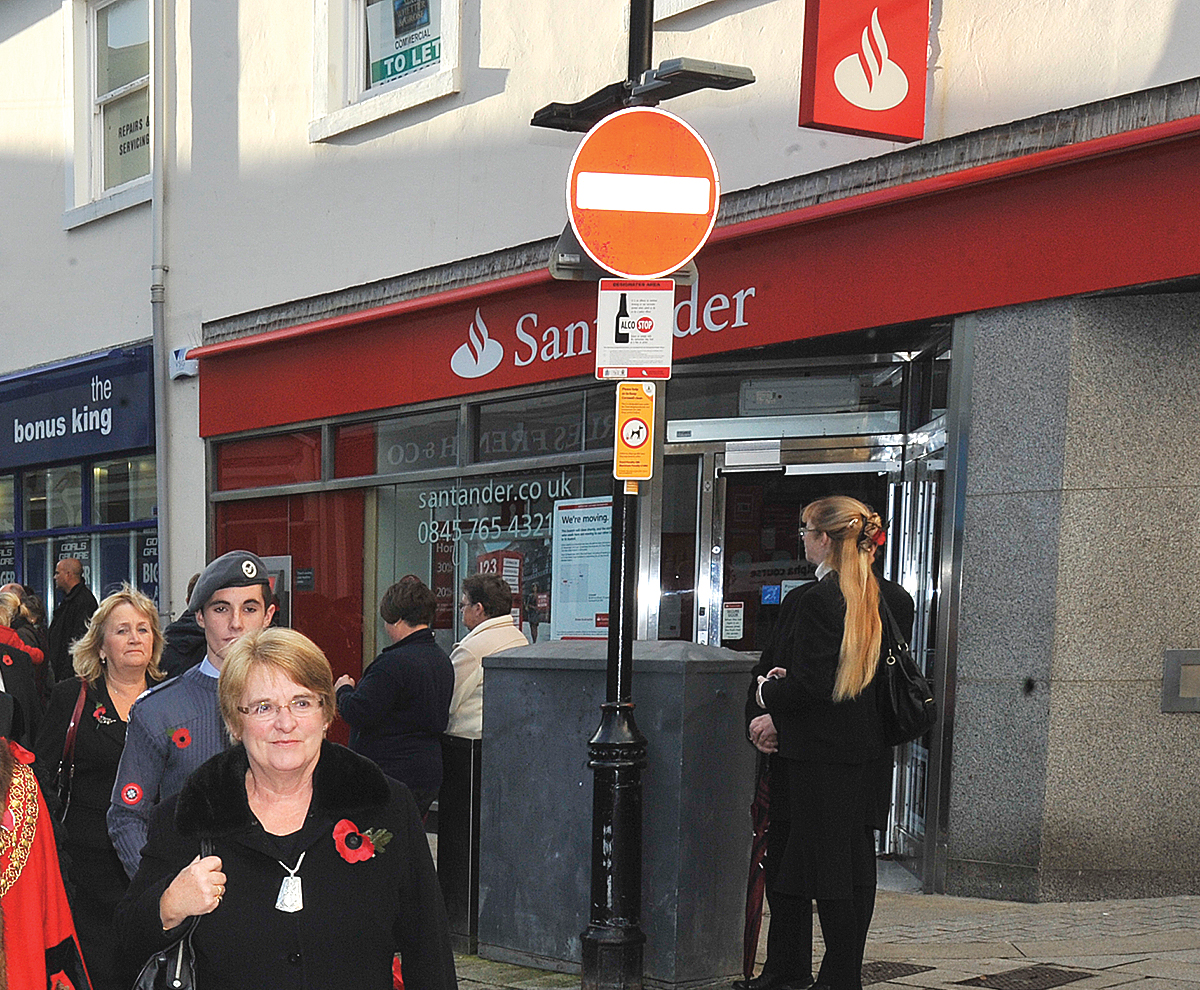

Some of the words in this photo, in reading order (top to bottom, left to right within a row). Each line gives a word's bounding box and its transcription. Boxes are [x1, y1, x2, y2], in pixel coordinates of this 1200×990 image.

[395, 28, 431, 50] COMMERCIAL
[384, 54, 405, 75] TO
[412, 40, 441, 66] LET
[118, 118, 143, 138] REPAIRS
[119, 133, 150, 155] SERVICING
[514, 279, 756, 367] Sander
[621, 320, 636, 330] ALCO
[638, 320, 653, 330] STOP
[91, 375, 112, 402] the
[14, 415, 67, 444] bonus
[71, 405, 112, 436] king
[548, 476, 572, 498] uk
[417, 518, 462, 544] 0845
[468, 516, 501, 541] 765
[507, 512, 552, 538] 4321
[561, 515, 581, 524] We're
[582, 512, 609, 524] moving.
[61, 541, 87, 551] GOALS
[479, 558, 497, 574] 123
